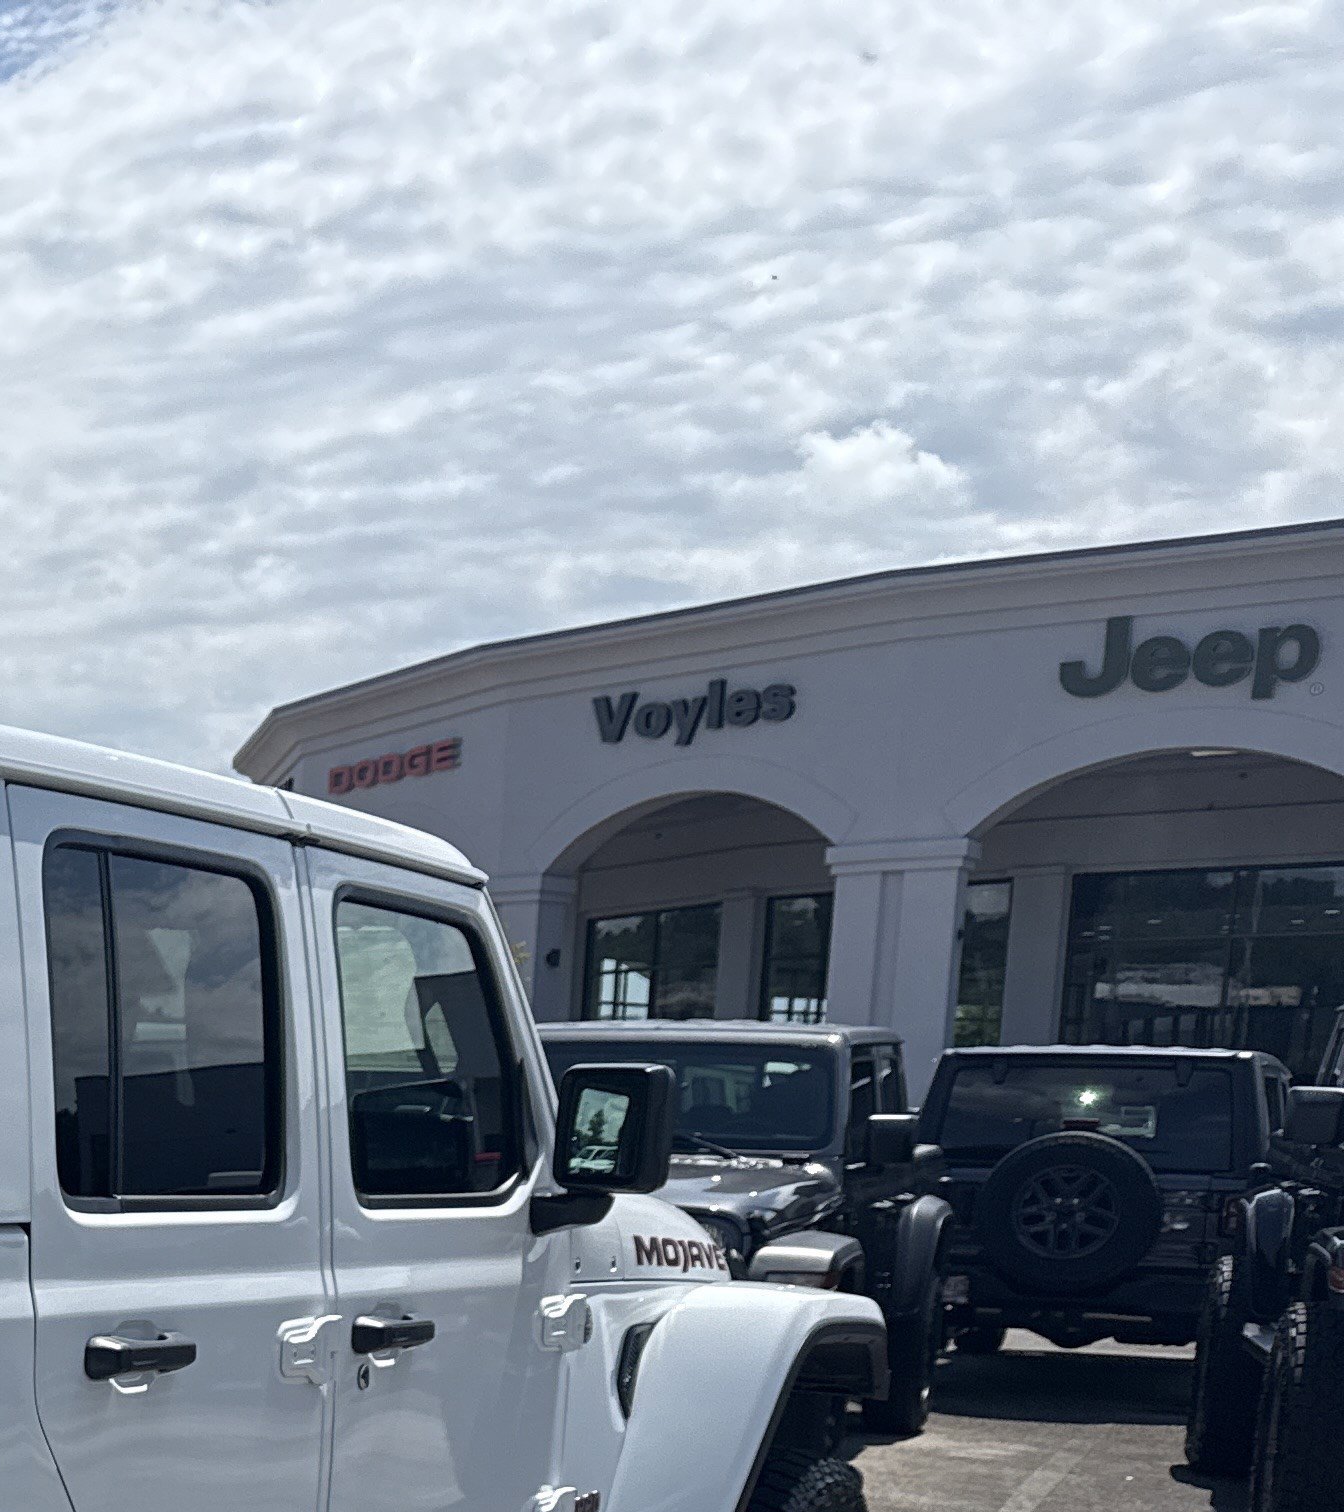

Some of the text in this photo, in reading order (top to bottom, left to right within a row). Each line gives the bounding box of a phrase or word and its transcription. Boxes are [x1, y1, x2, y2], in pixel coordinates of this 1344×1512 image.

[1059, 615, 1320, 701] Jeep
[592, 678, 797, 746] Voyles
[328, 737, 462, 795] DODGE
[633, 1233, 727, 1273] MOJAVE
